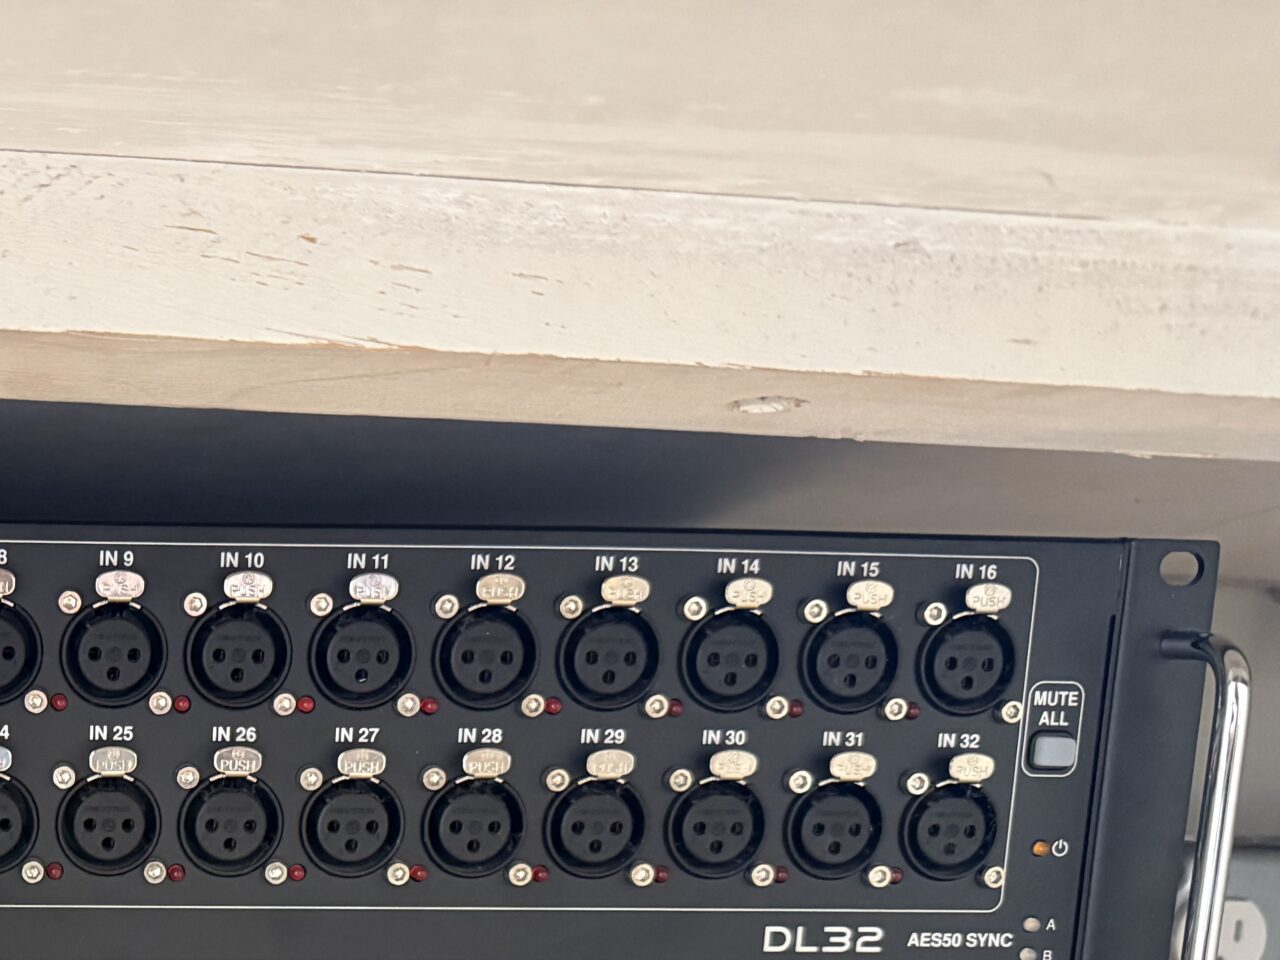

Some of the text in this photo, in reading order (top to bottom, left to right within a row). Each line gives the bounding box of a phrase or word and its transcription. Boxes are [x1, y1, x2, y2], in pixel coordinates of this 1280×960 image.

[99, 549, 134, 567] IN 9
[220, 551, 265, 569] IN 10
[347, 552, 389, 570] IN 11
[470, 553, 516, 571] IN 12
[594, 555, 639, 573] IN 13
[717, 557, 761, 575] IN 14
[836, 560, 880, 578] IN 15
[955, 563, 998, 580] IN 16
[972, 594, 1007, 608] PUSH
[1034, 691, 1078, 706] MUTE
[1038, 710, 1069, 726] ALL
[89, 724, 134, 742] IN 25
[212, 726, 257, 743] IN 26
[334, 726, 380, 743] IN 27
[457, 727, 503, 744] IN 28
[580, 728, 626, 745] IN 29
[702, 729, 747, 746] IN 30
[822, 731, 864, 747] IN 31
[937, 732, 981, 749] IN 32
[219, 758, 257, 772] PUSH
[1046, 919, 1056, 931] A
[762, 926, 885, 953] DL32
[907, 933, 1013, 947] AES50 SYNC
